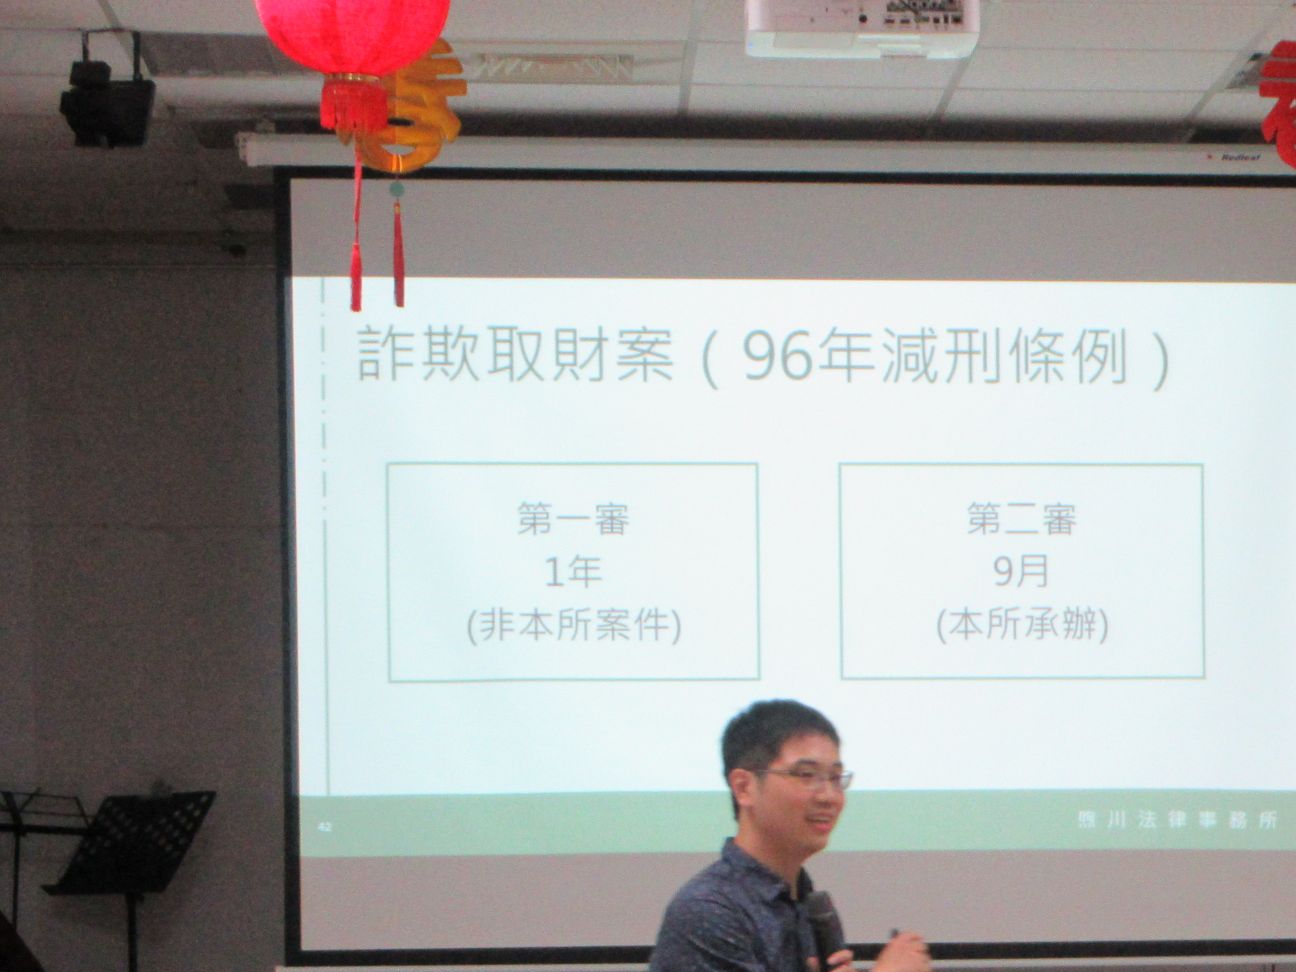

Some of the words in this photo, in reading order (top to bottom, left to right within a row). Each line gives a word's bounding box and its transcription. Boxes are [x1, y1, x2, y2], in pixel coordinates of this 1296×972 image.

[517, 501, 630, 536] 第一審
[967, 501, 1077, 536] 第二審
[545, 553, 604, 589] 1年
[993, 553, 1048, 589] 9月
[467, 606, 682, 647] (非本所案件)
[936, 605, 1109, 645] (本所承辦)
